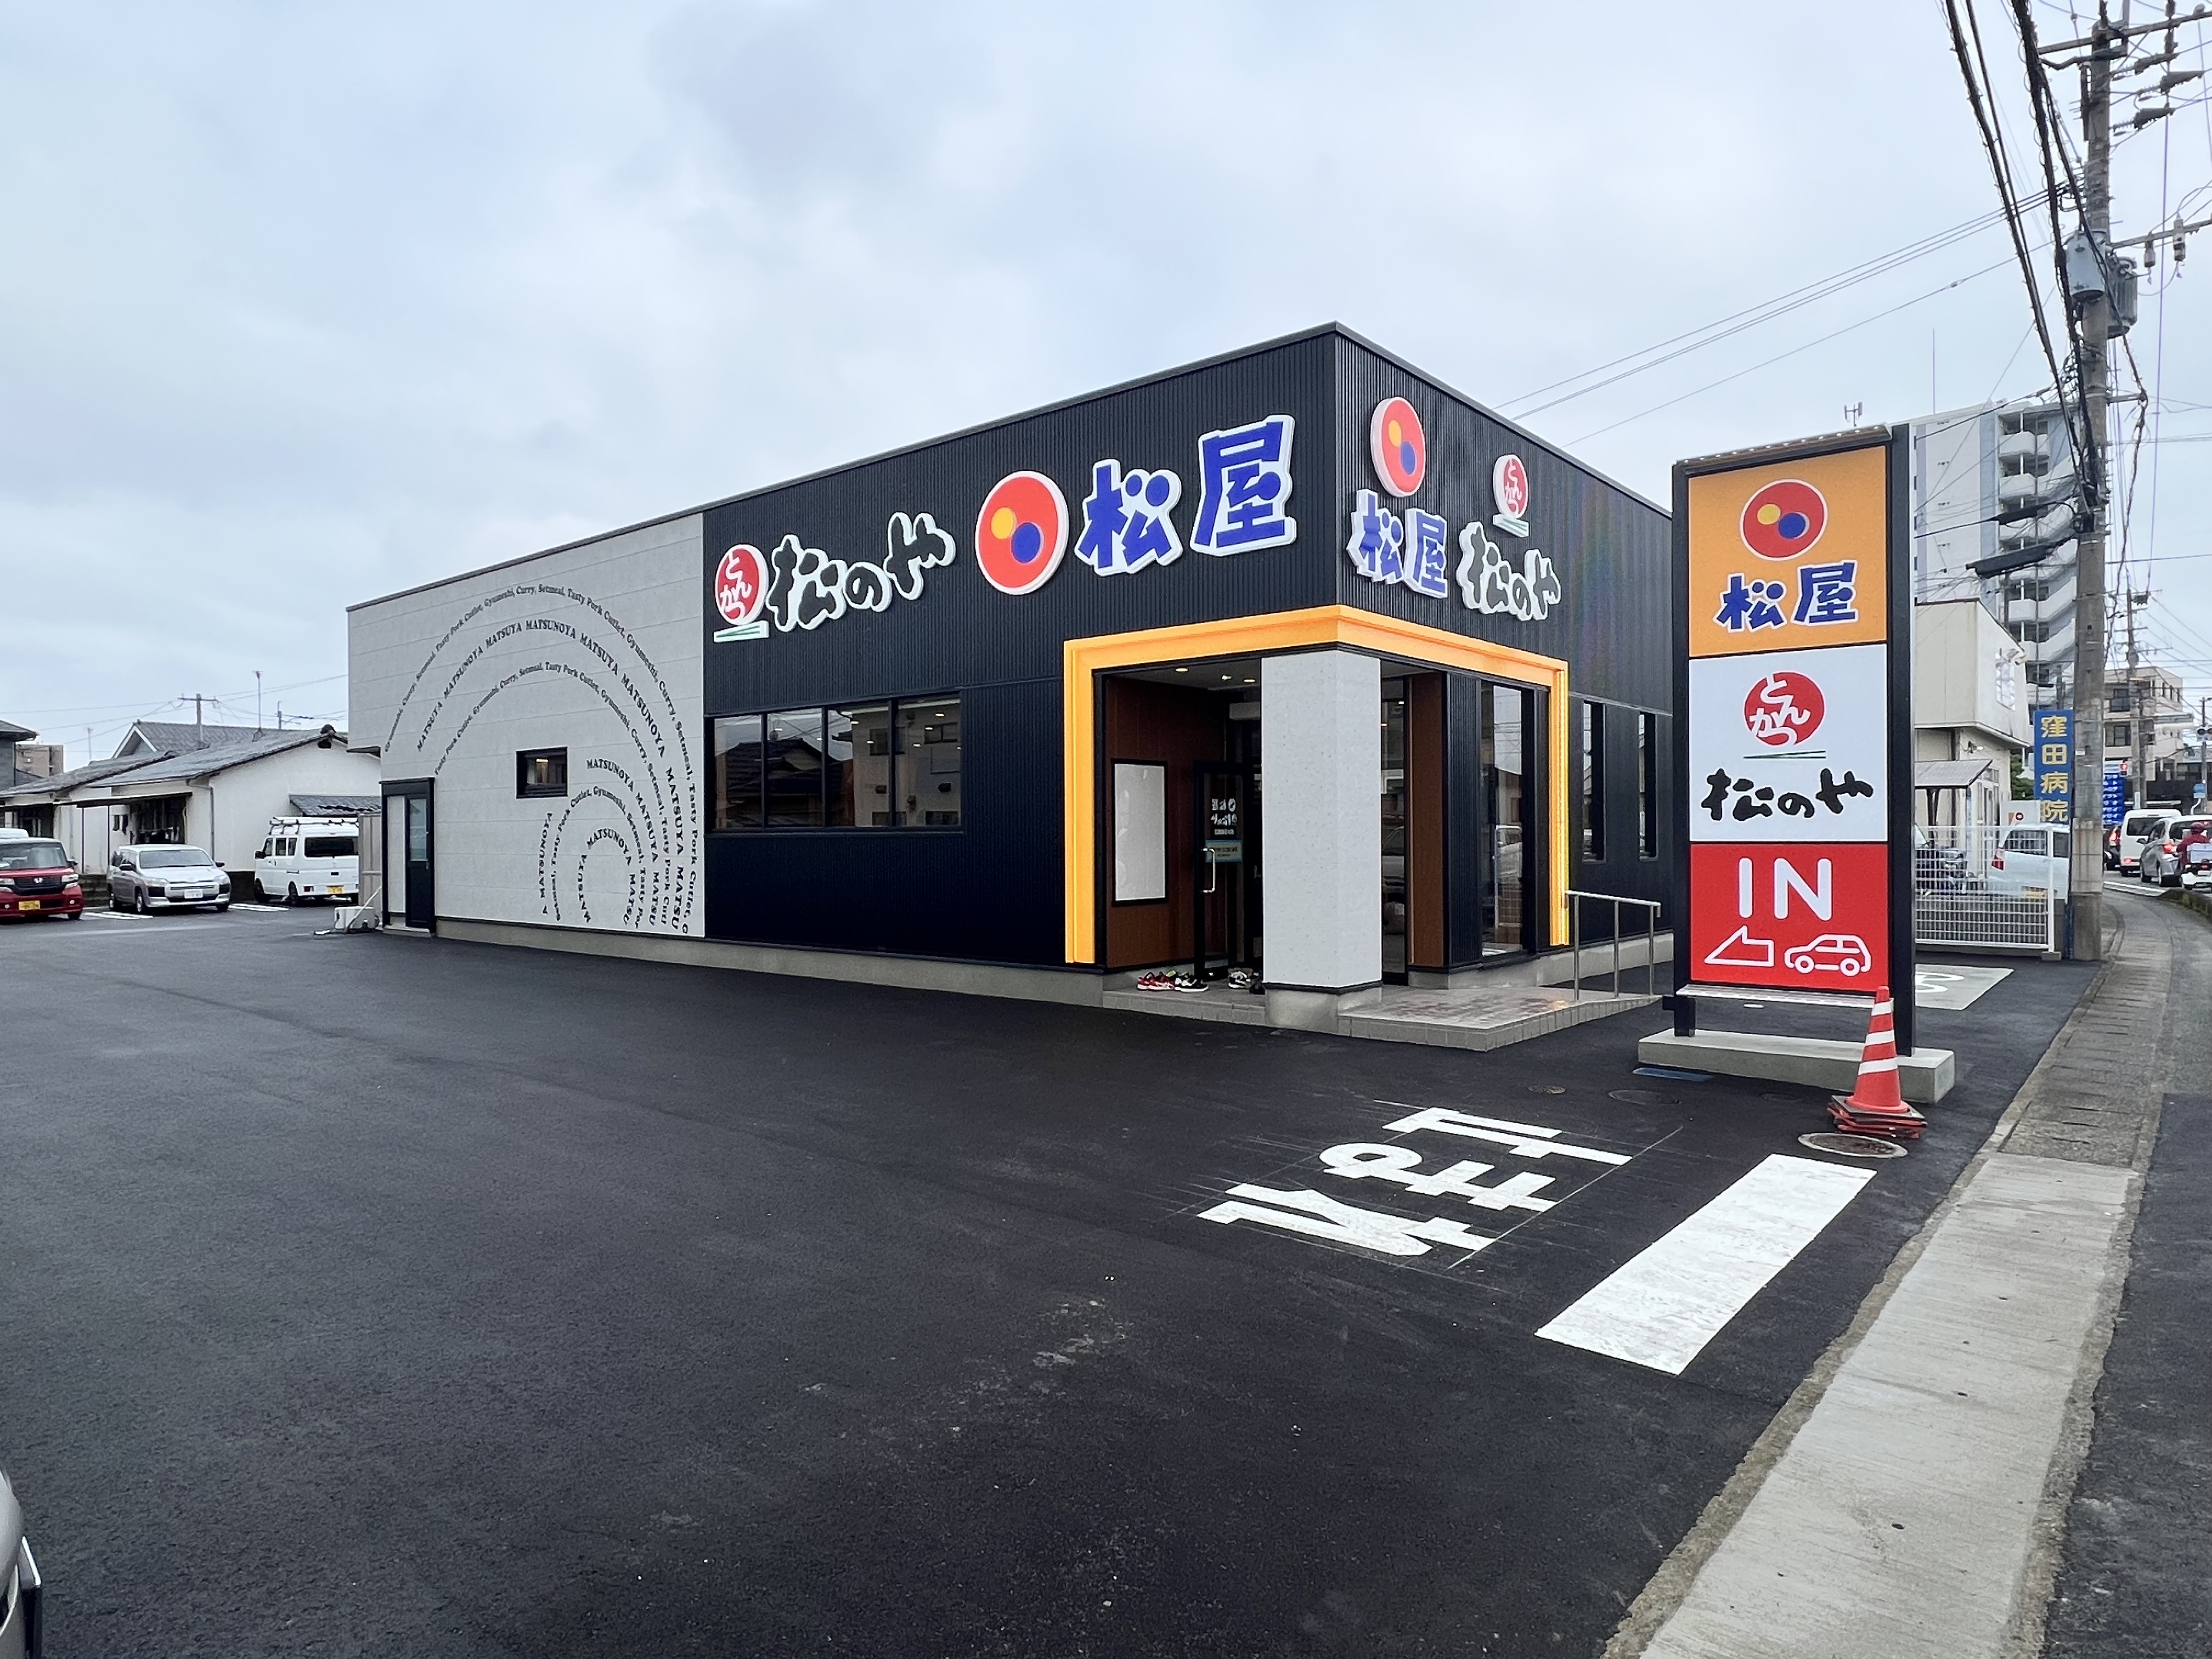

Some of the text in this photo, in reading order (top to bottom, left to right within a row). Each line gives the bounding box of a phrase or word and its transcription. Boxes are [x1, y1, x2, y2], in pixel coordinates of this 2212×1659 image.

[1076, 418, 1288, 572] 松屋
[768, 515, 949, 629] 松のや
[1356, 491, 1447, 595] 松屋
[1466, 525, 1560, 617] 松のや
[720, 551, 752, 619] とんかつ
[1714, 561, 1858, 632] 松屋
[485, 622, 522, 649] MATSUYA
[526, 619, 576, 640] MATSUNOYA
[579, 632, 618, 676] MATSUYA
[621, 672, 665, 758] MATSUNOYA
[1749, 672, 1811, 746] とんかつ
[1701, 768, 1874, 821] 松のや
[2040, 714, 2069, 823] 窪田病院
[586, 758, 659, 926] MATSUNOYA MATSUYA MATSU
[586, 828, 632, 866] MATSUNOYA
[665, 766, 684, 856] MATSUYA
[672, 866, 684, 930] MATSU
[1738, 856, 1832, 922] IN
